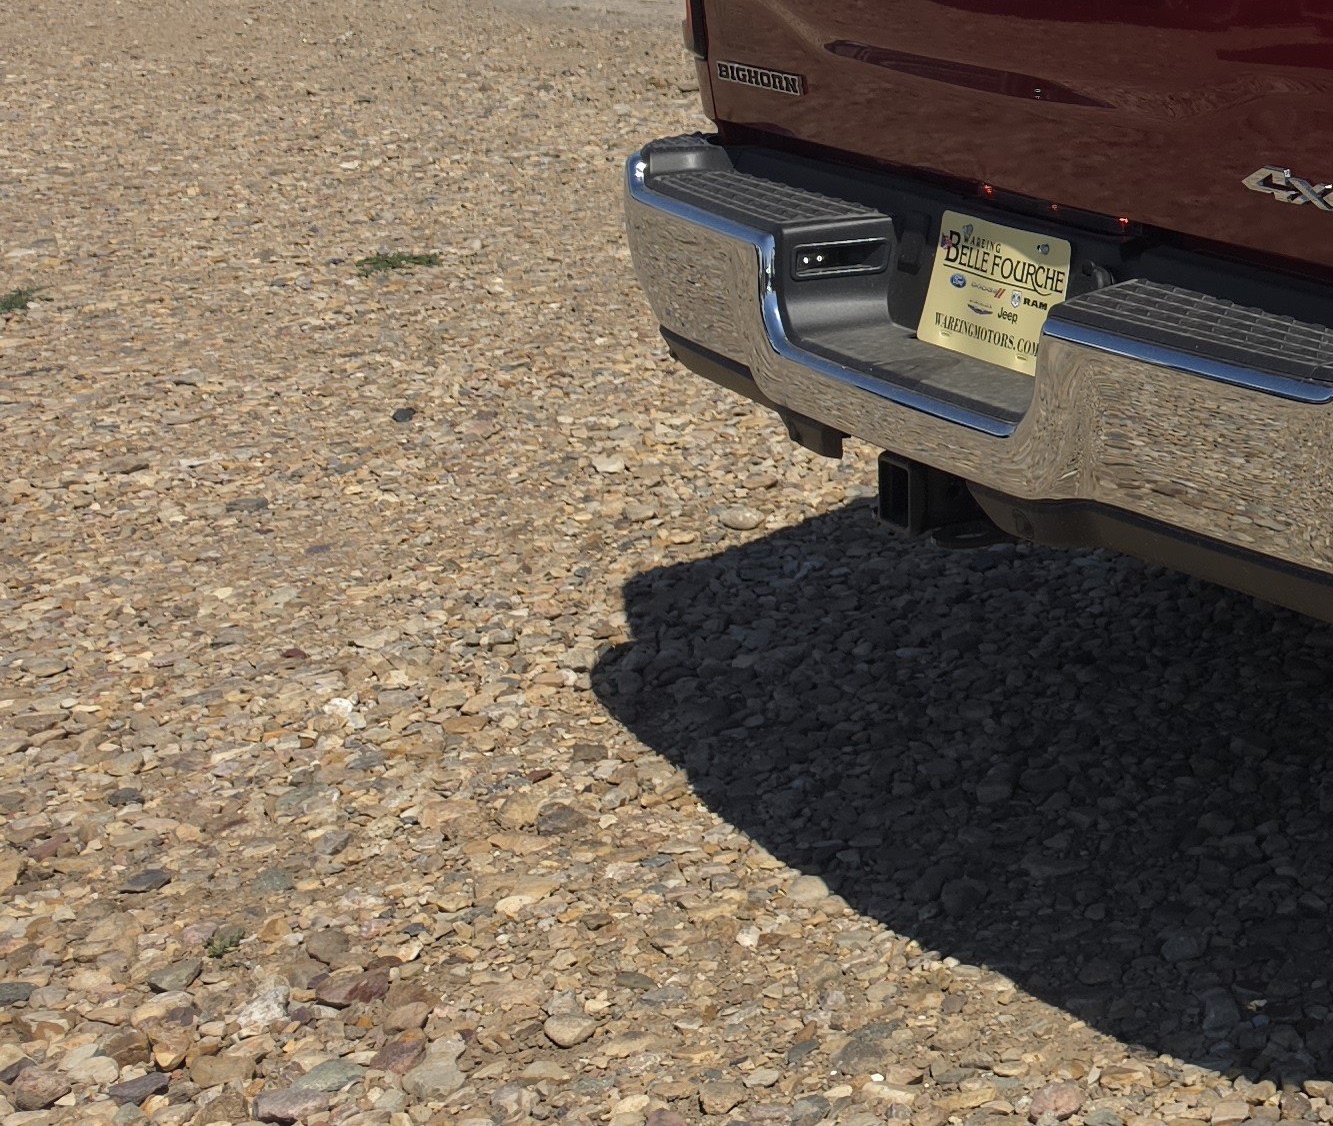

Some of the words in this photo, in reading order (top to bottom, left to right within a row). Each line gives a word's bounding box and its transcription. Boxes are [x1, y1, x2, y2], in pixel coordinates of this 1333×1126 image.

[717, 61, 800, 95] BIGHORN
[944, 230, 989, 273] BELLE
[991, 254, 1065, 296] FOURCHE
[997, 306, 1019, 325] Jeep
[1023, 296, 1049, 311] RAM
[934, 311, 1040, 358] WAREINGMOTORS.COM
